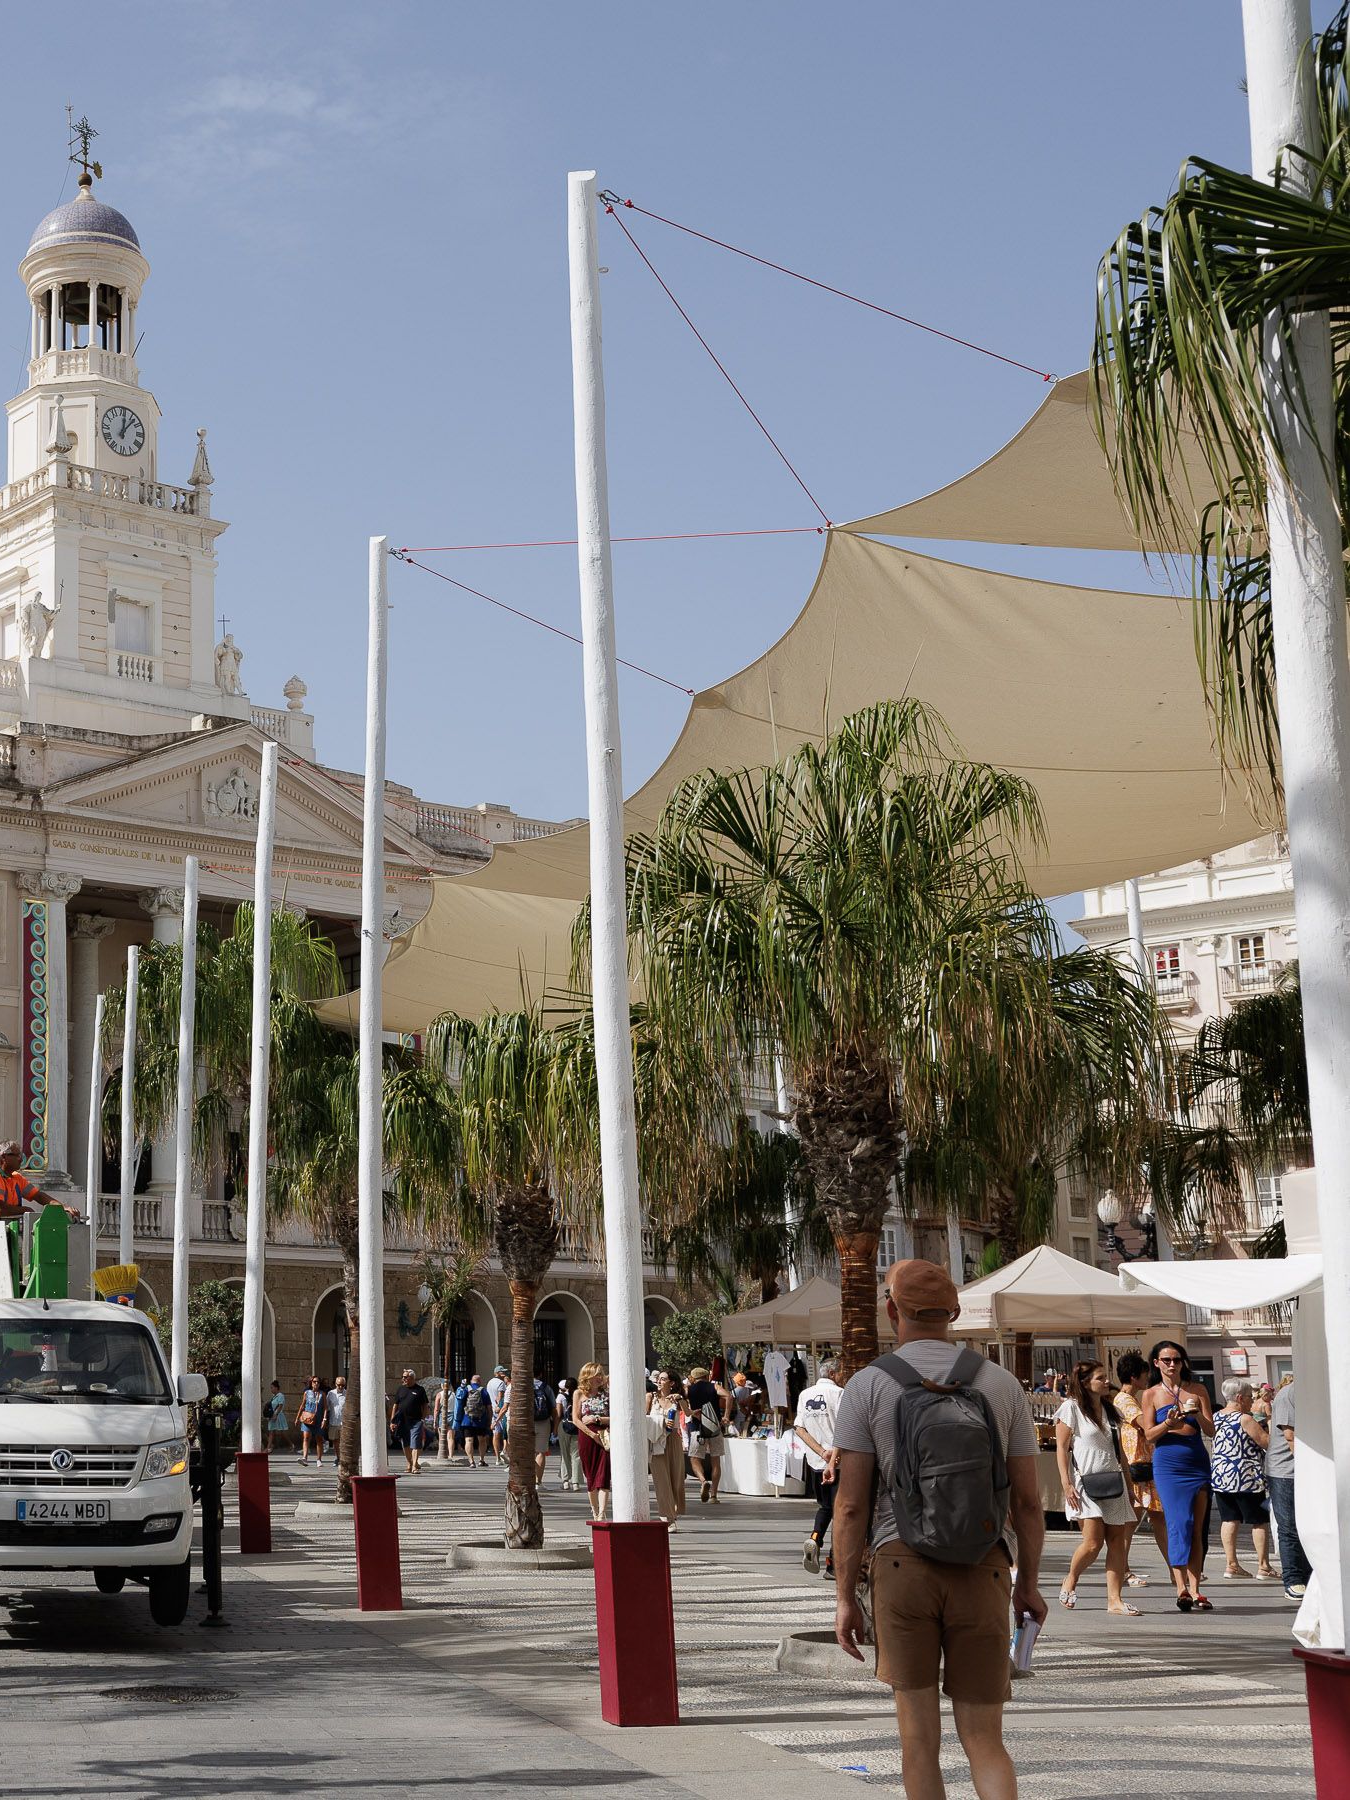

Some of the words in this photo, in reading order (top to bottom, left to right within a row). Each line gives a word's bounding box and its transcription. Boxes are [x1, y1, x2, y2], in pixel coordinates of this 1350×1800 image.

[52, 839, 77, 850] CASAS
[155, 853, 166, 863] LA
[29, 1503, 70, 1519] 4244
[75, 1503, 105, 1519] MBD
